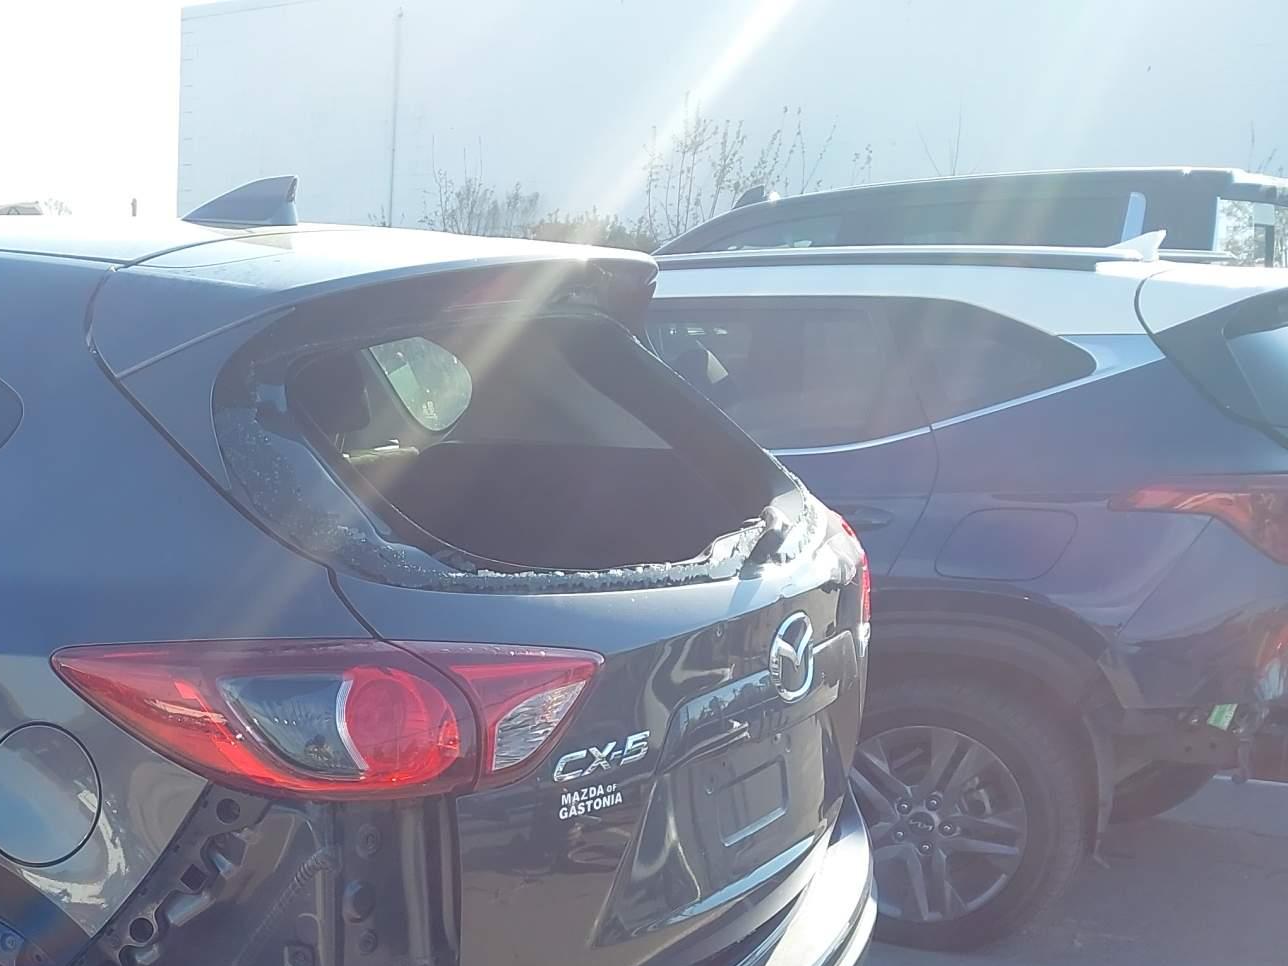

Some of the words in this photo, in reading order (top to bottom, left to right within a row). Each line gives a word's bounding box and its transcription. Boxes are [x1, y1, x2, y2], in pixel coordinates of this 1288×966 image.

[553, 730, 651, 783] CX-5
[558, 791, 623, 820] GASTONIA
[561, 784, 605, 806] MAZDA
[606, 783, 618, 793] OF
